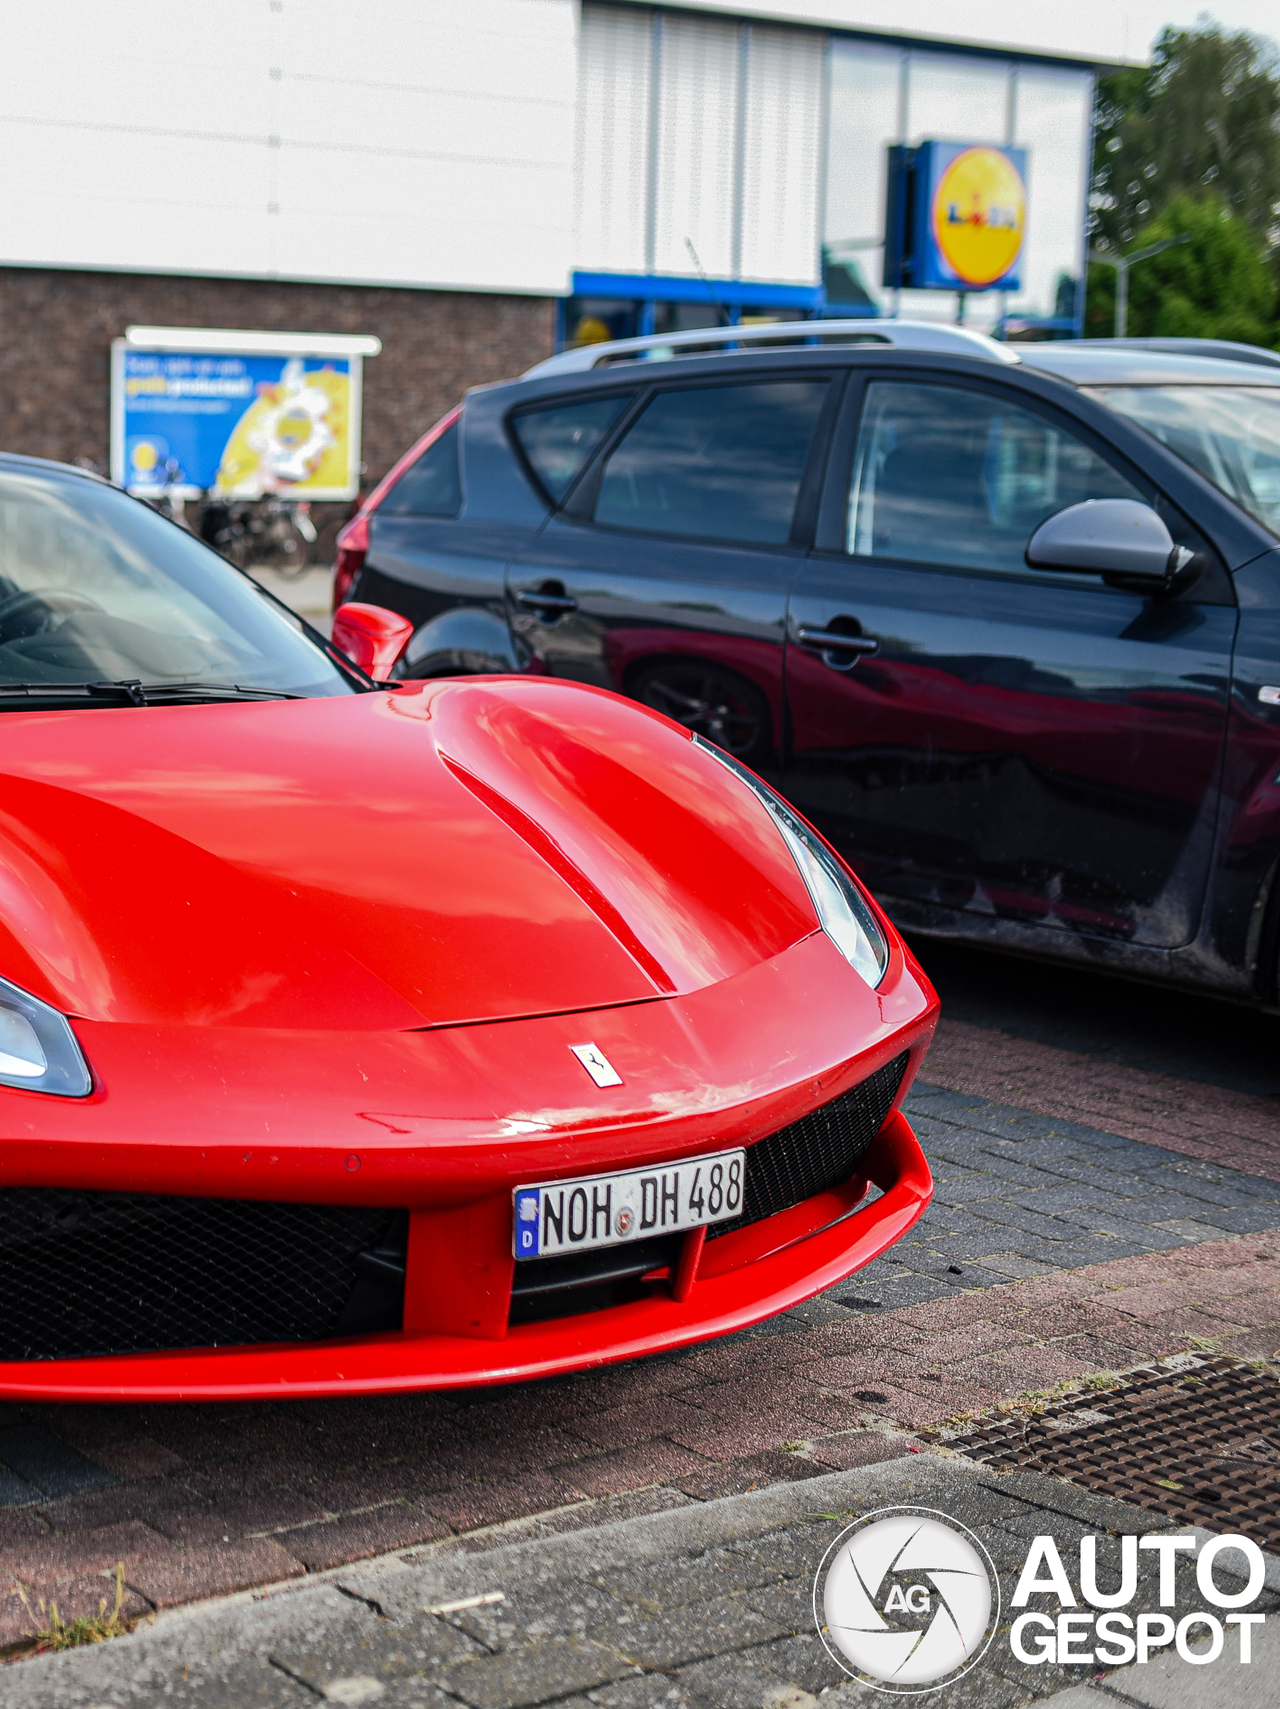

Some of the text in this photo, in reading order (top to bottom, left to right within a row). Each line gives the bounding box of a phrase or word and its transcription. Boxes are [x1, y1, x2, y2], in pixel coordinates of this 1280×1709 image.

[543, 1159, 741, 1247] NOH DH 488
[522, 1230, 533, 1248] D
